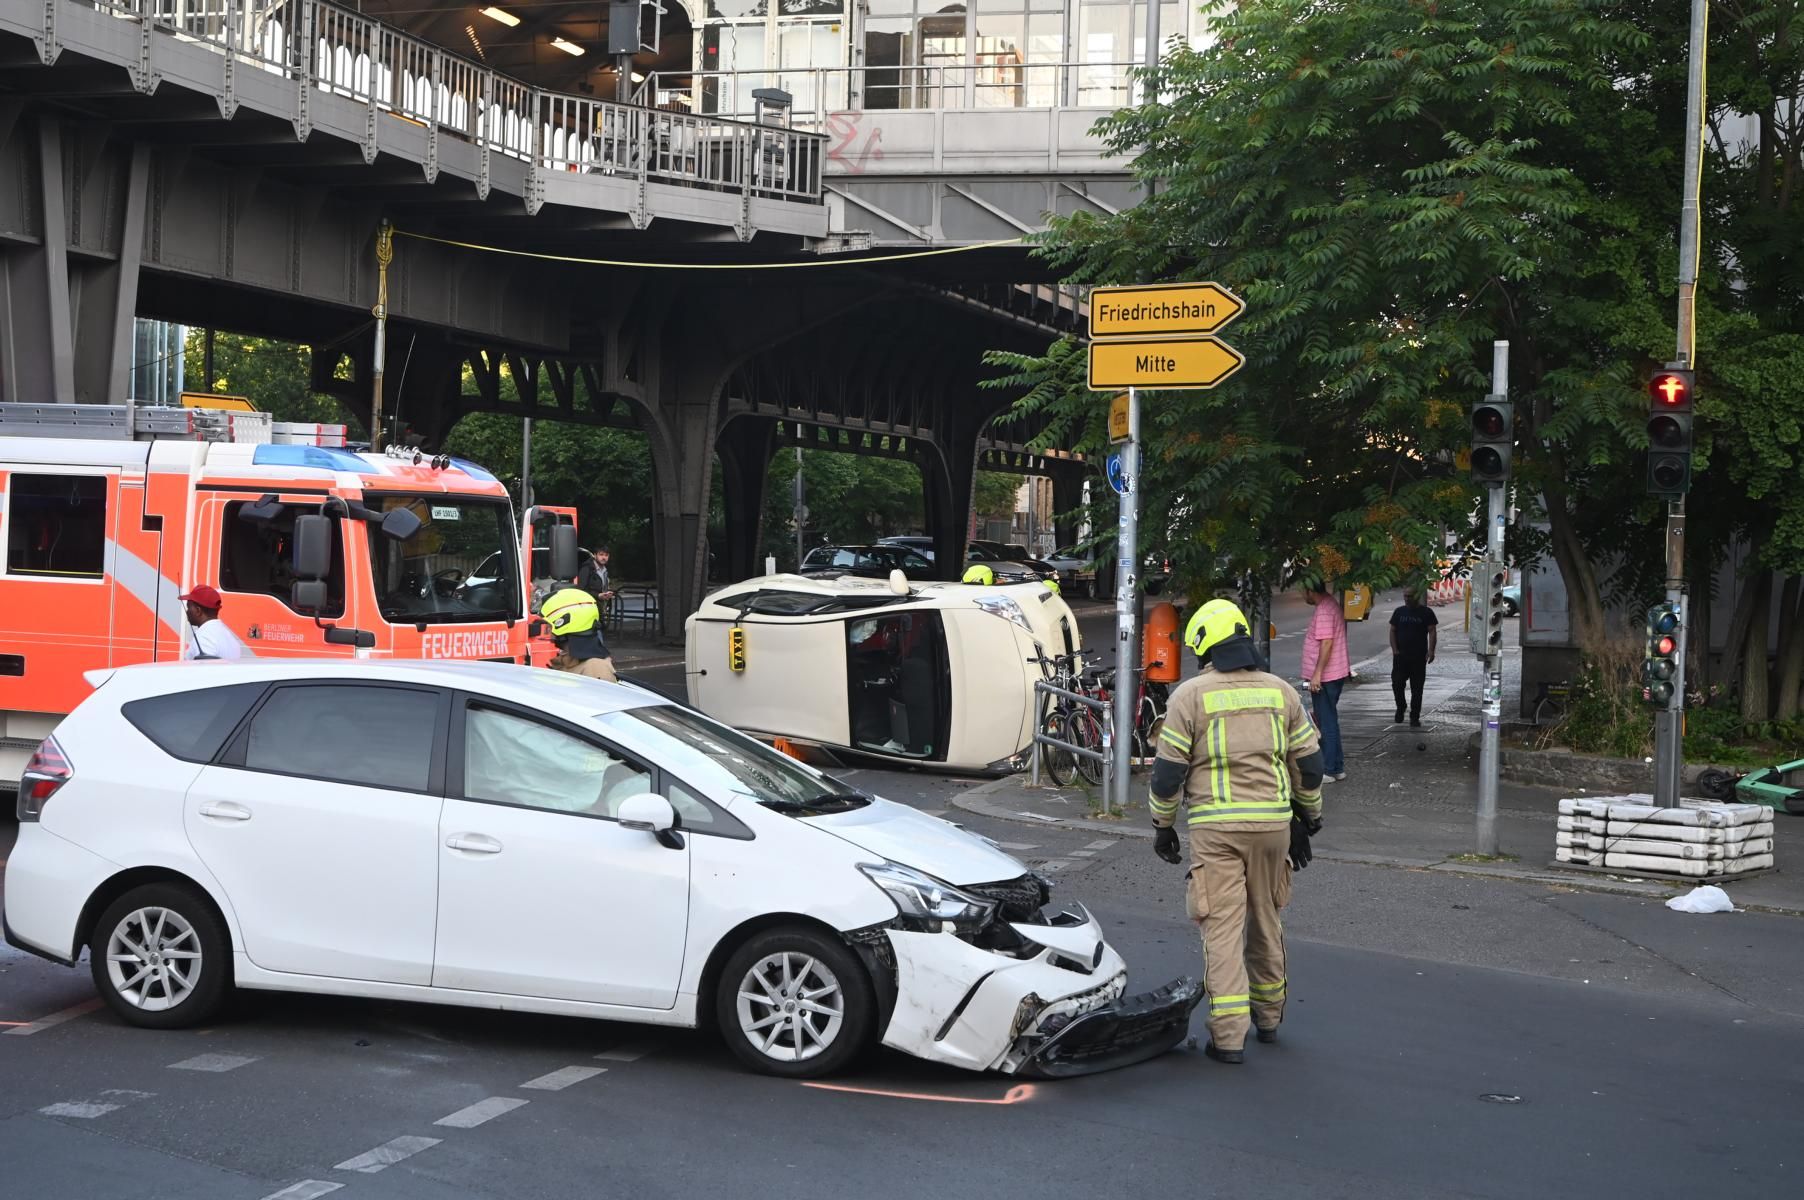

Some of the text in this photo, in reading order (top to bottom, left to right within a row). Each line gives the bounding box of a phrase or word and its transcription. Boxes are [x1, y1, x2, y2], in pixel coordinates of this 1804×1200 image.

[1100, 300, 1215, 322] Friedrichshain
[1136, 355, 1176, 373] Mitte
[264, 623, 292, 631] BERLINER
[264, 632, 304, 643] FEUERWEHR
[422, 630, 509, 659] FEUERWEHR
[734, 636, 743, 665] TAXI
[1231, 695, 1277, 706] FEUERWEHR
